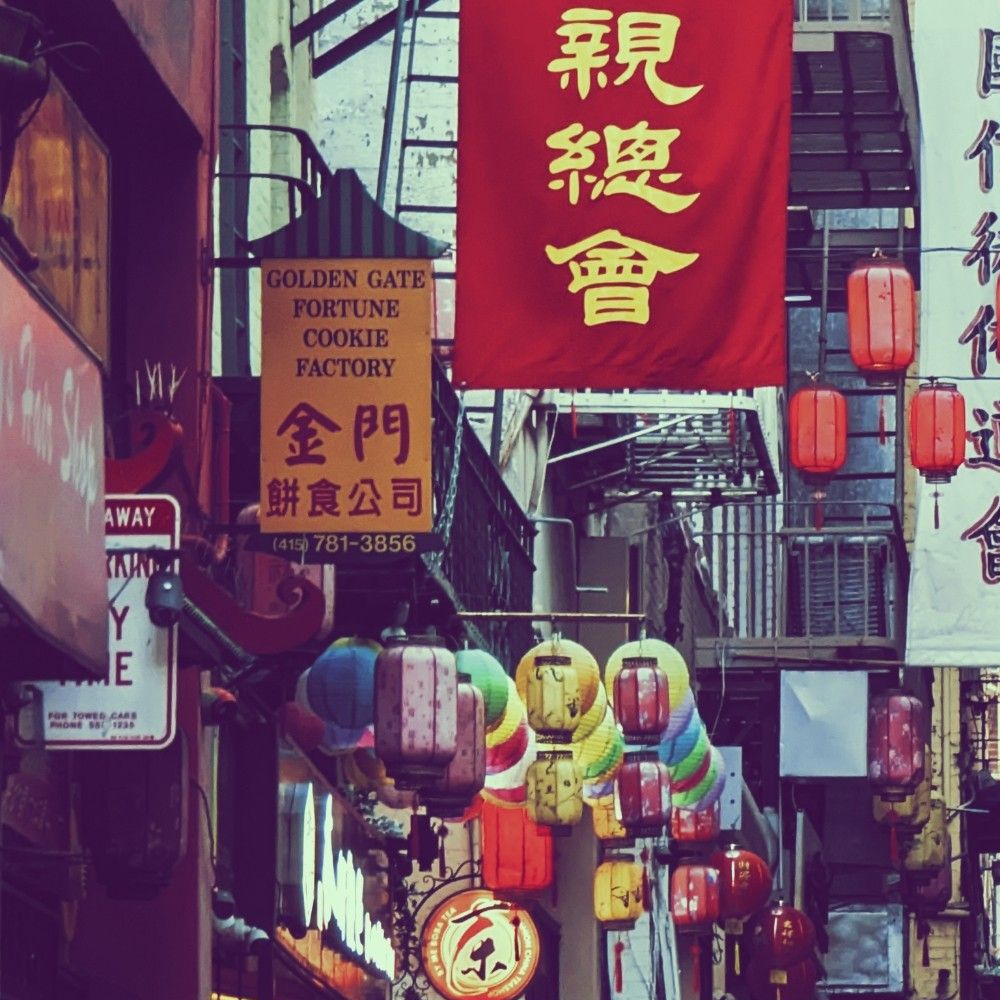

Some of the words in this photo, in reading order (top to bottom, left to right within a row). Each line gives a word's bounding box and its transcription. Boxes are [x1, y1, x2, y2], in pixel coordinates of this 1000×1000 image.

[545, 7, 704, 327] 親總會
[266, 269, 358, 289] GOLDEN
[367, 269, 425, 289] GATE
[292, 299, 400, 318] FORTUNE
[303, 329, 389, 348] COOKIE
[296, 358, 396, 377] FACTORY
[276, 402, 410, 467] 金門
[272, 537, 309, 552] (415)
[313, 534, 416, 553] 781-3856
